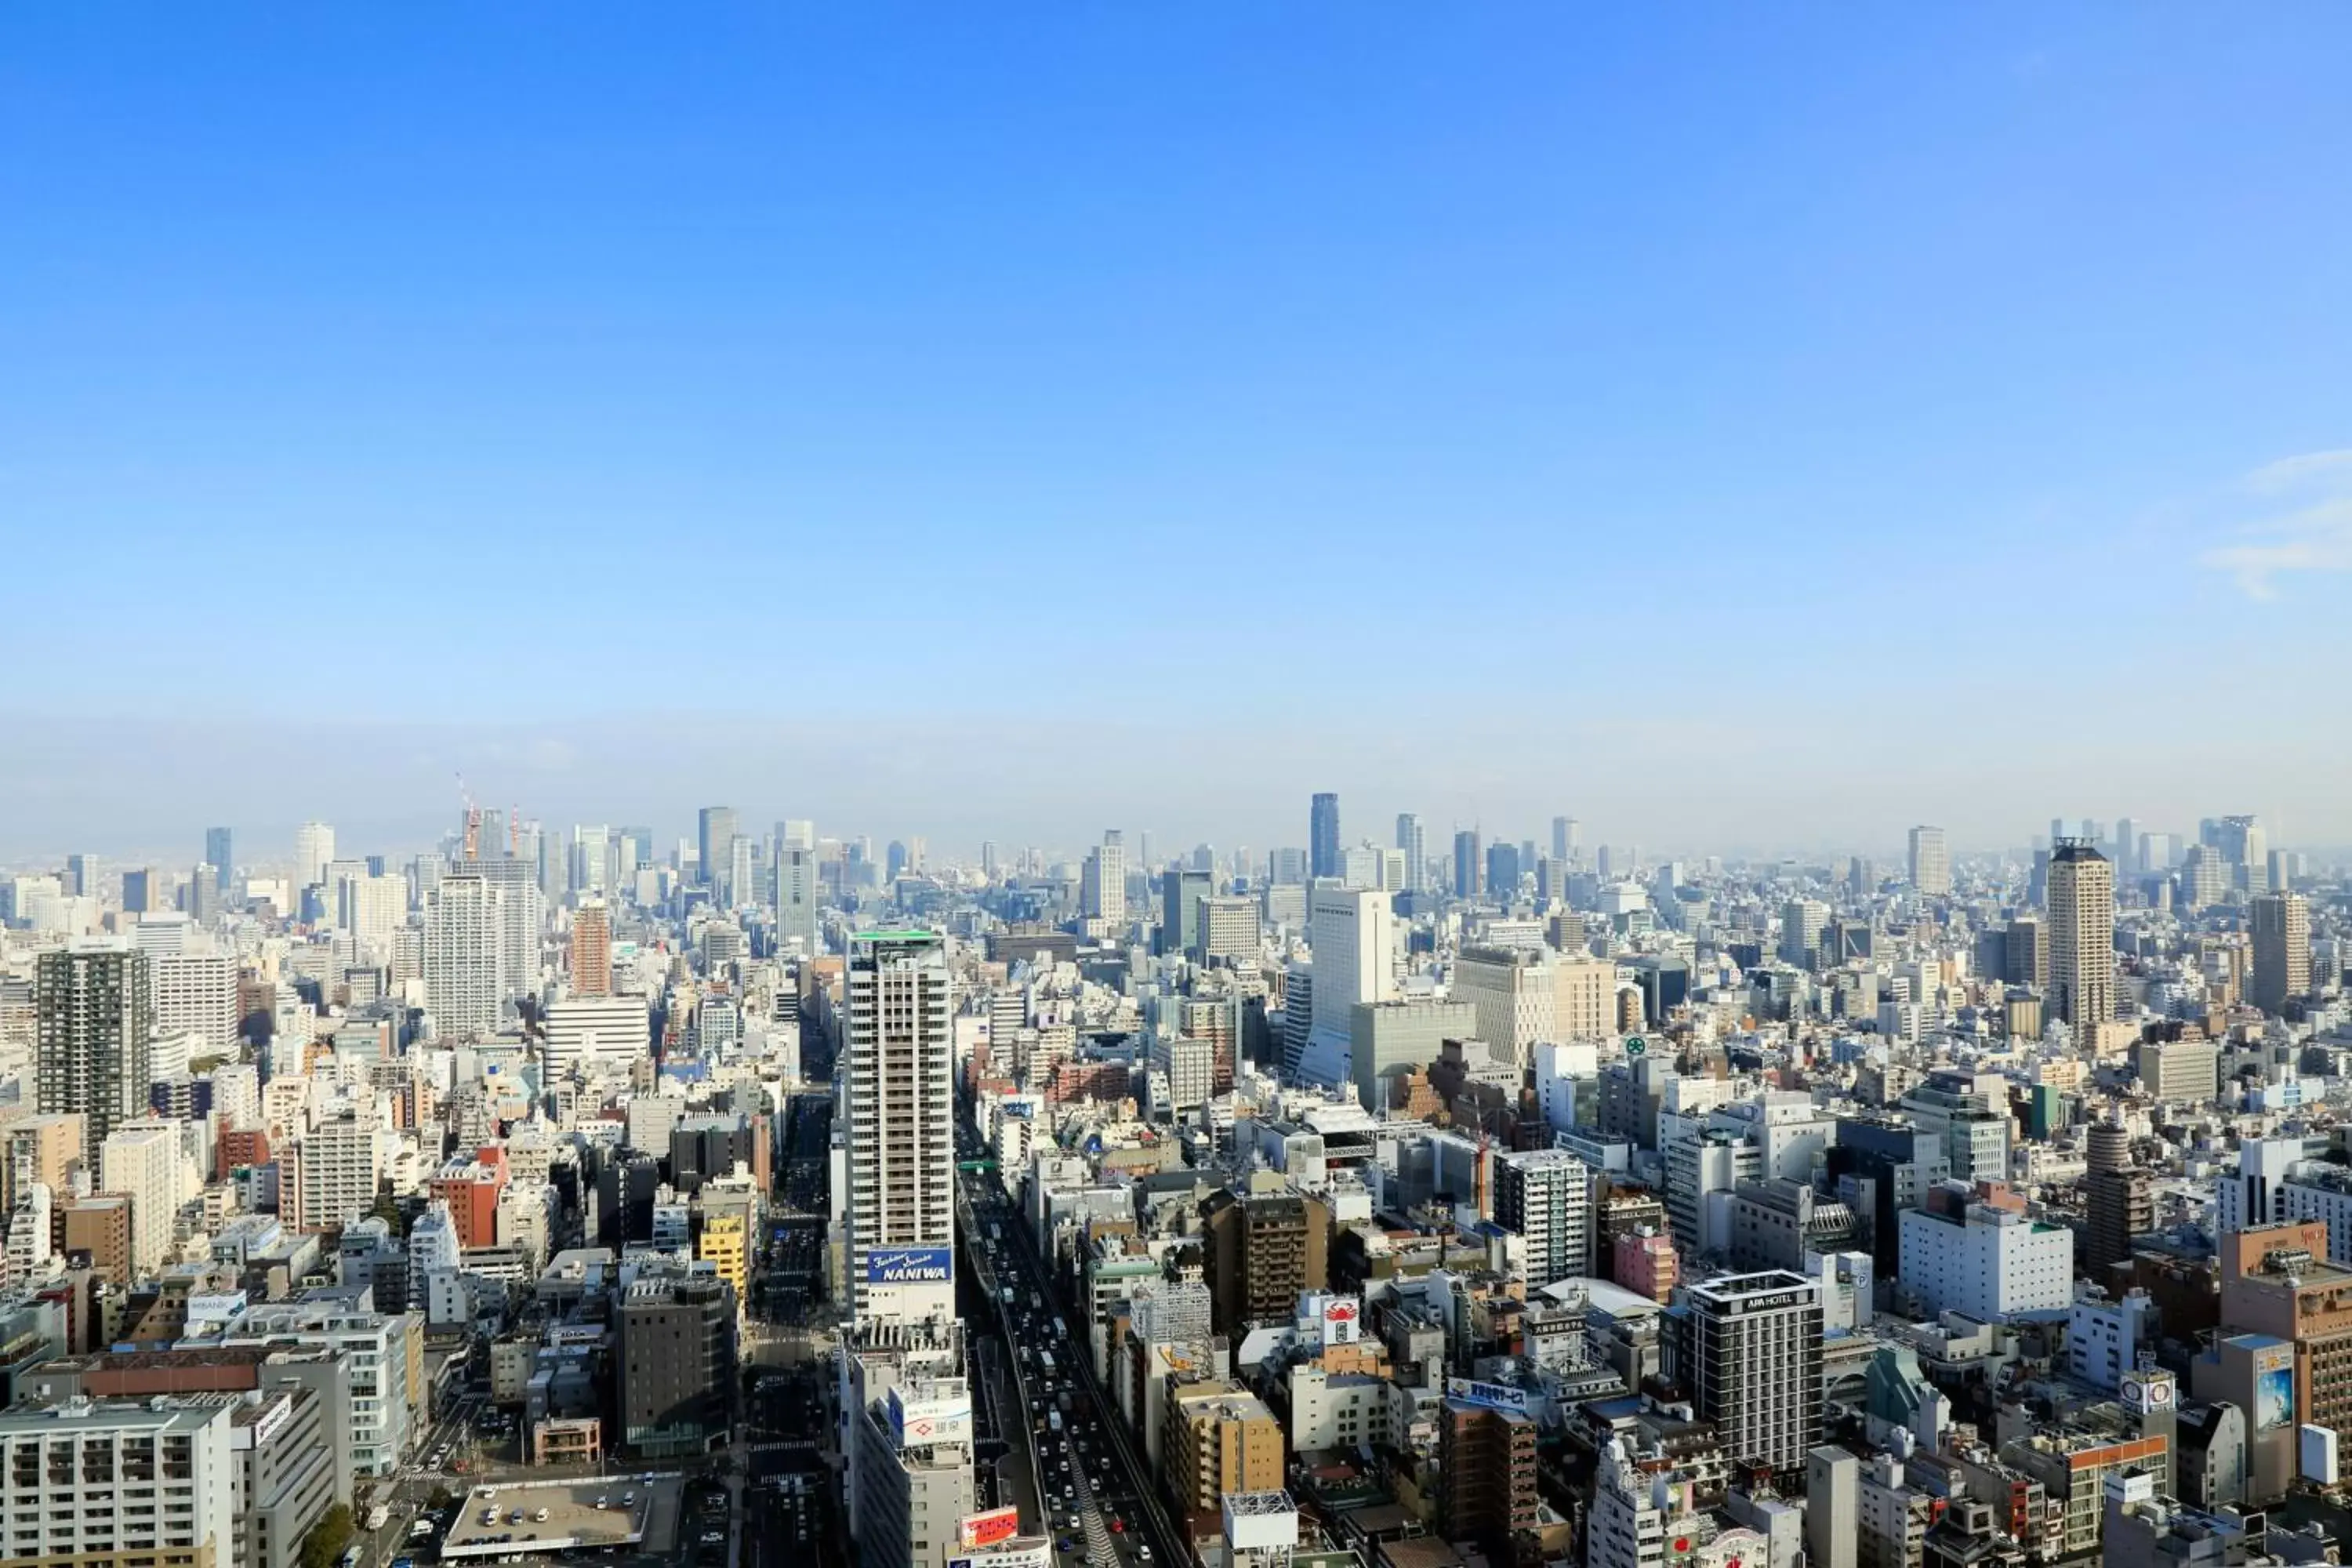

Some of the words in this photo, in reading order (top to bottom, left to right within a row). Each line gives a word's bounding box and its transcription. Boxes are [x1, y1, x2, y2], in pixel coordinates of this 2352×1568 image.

[884, 1266, 946, 1280] NANIWA
[1859, 1276, 1866, 1286] P
[1748, 1298, 1764, 1308] APA
[1766, 1294, 1792, 1306] HOTEL
